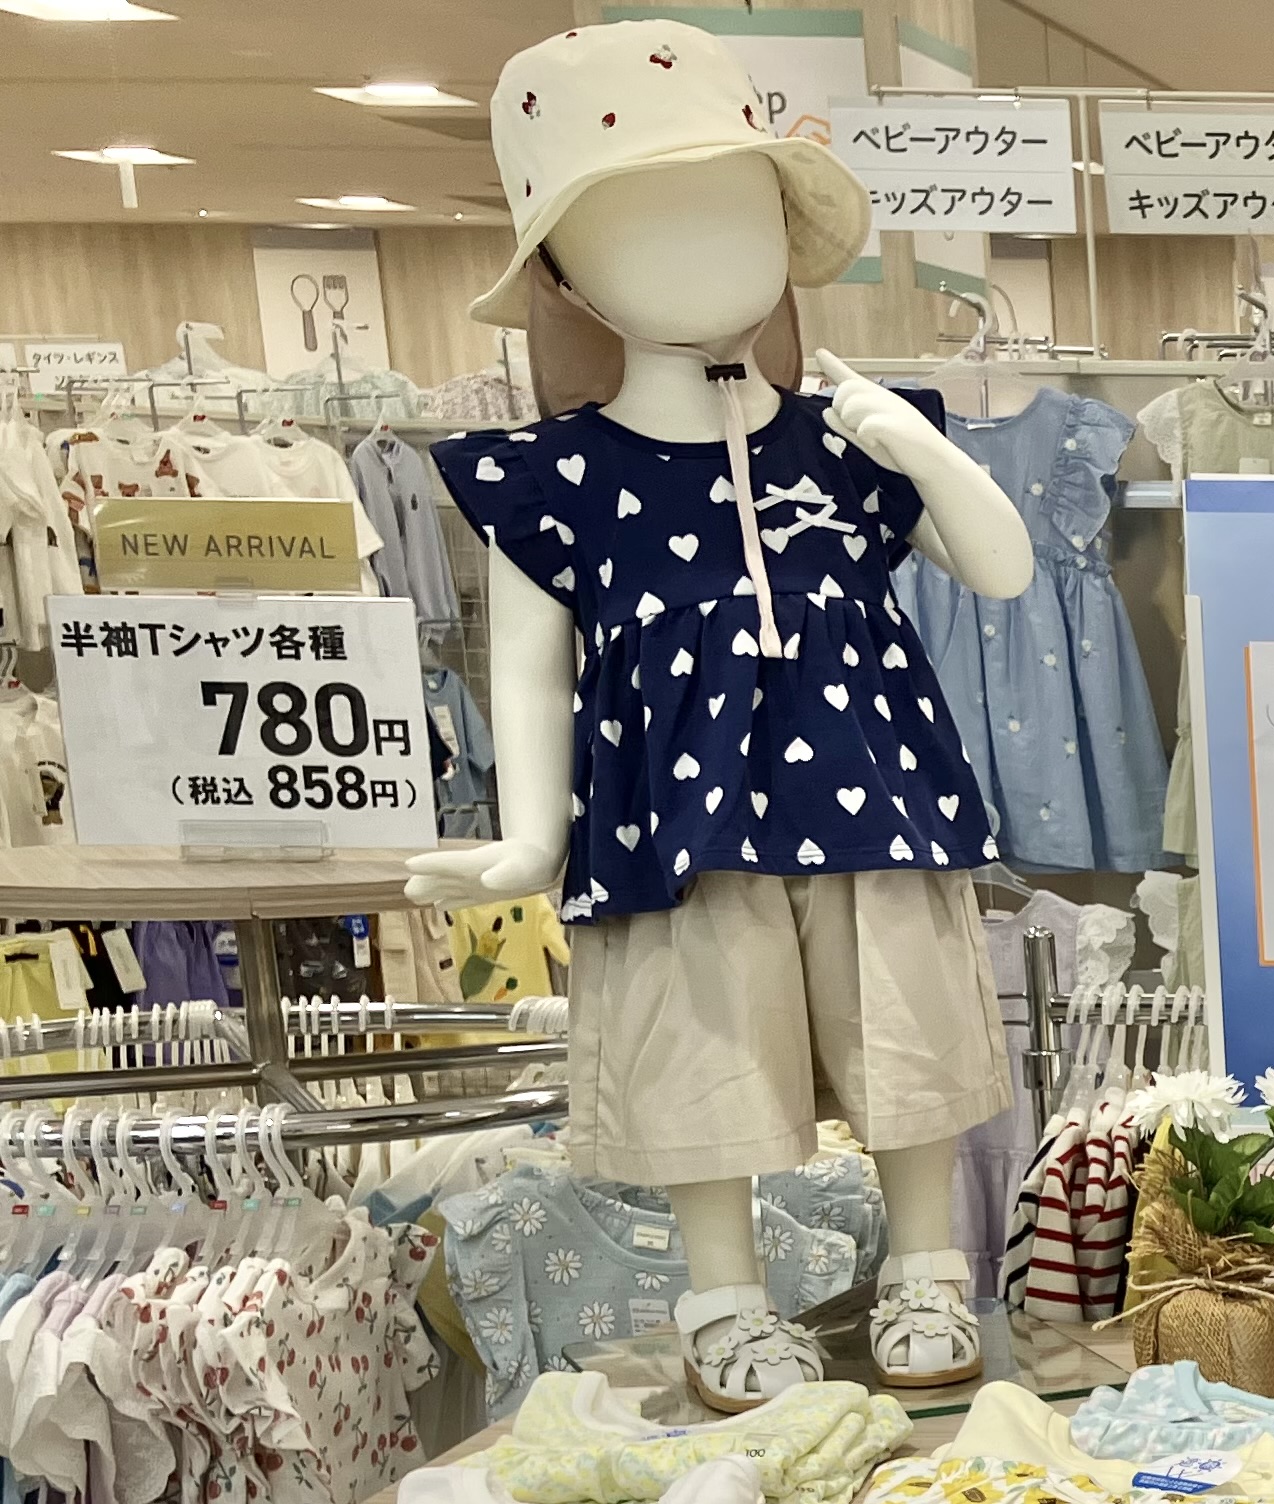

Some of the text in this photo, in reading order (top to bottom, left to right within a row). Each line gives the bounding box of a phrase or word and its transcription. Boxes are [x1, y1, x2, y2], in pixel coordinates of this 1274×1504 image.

[852, 123, 1048, 157] ベビーアウター
[121, 533, 336, 560] NEW ARRIVAL
[61, 621, 347, 661] 半袖Tシャツ各種
[200, 680, 412, 758] 780円
[746, 1448, 766, 1458] 100
